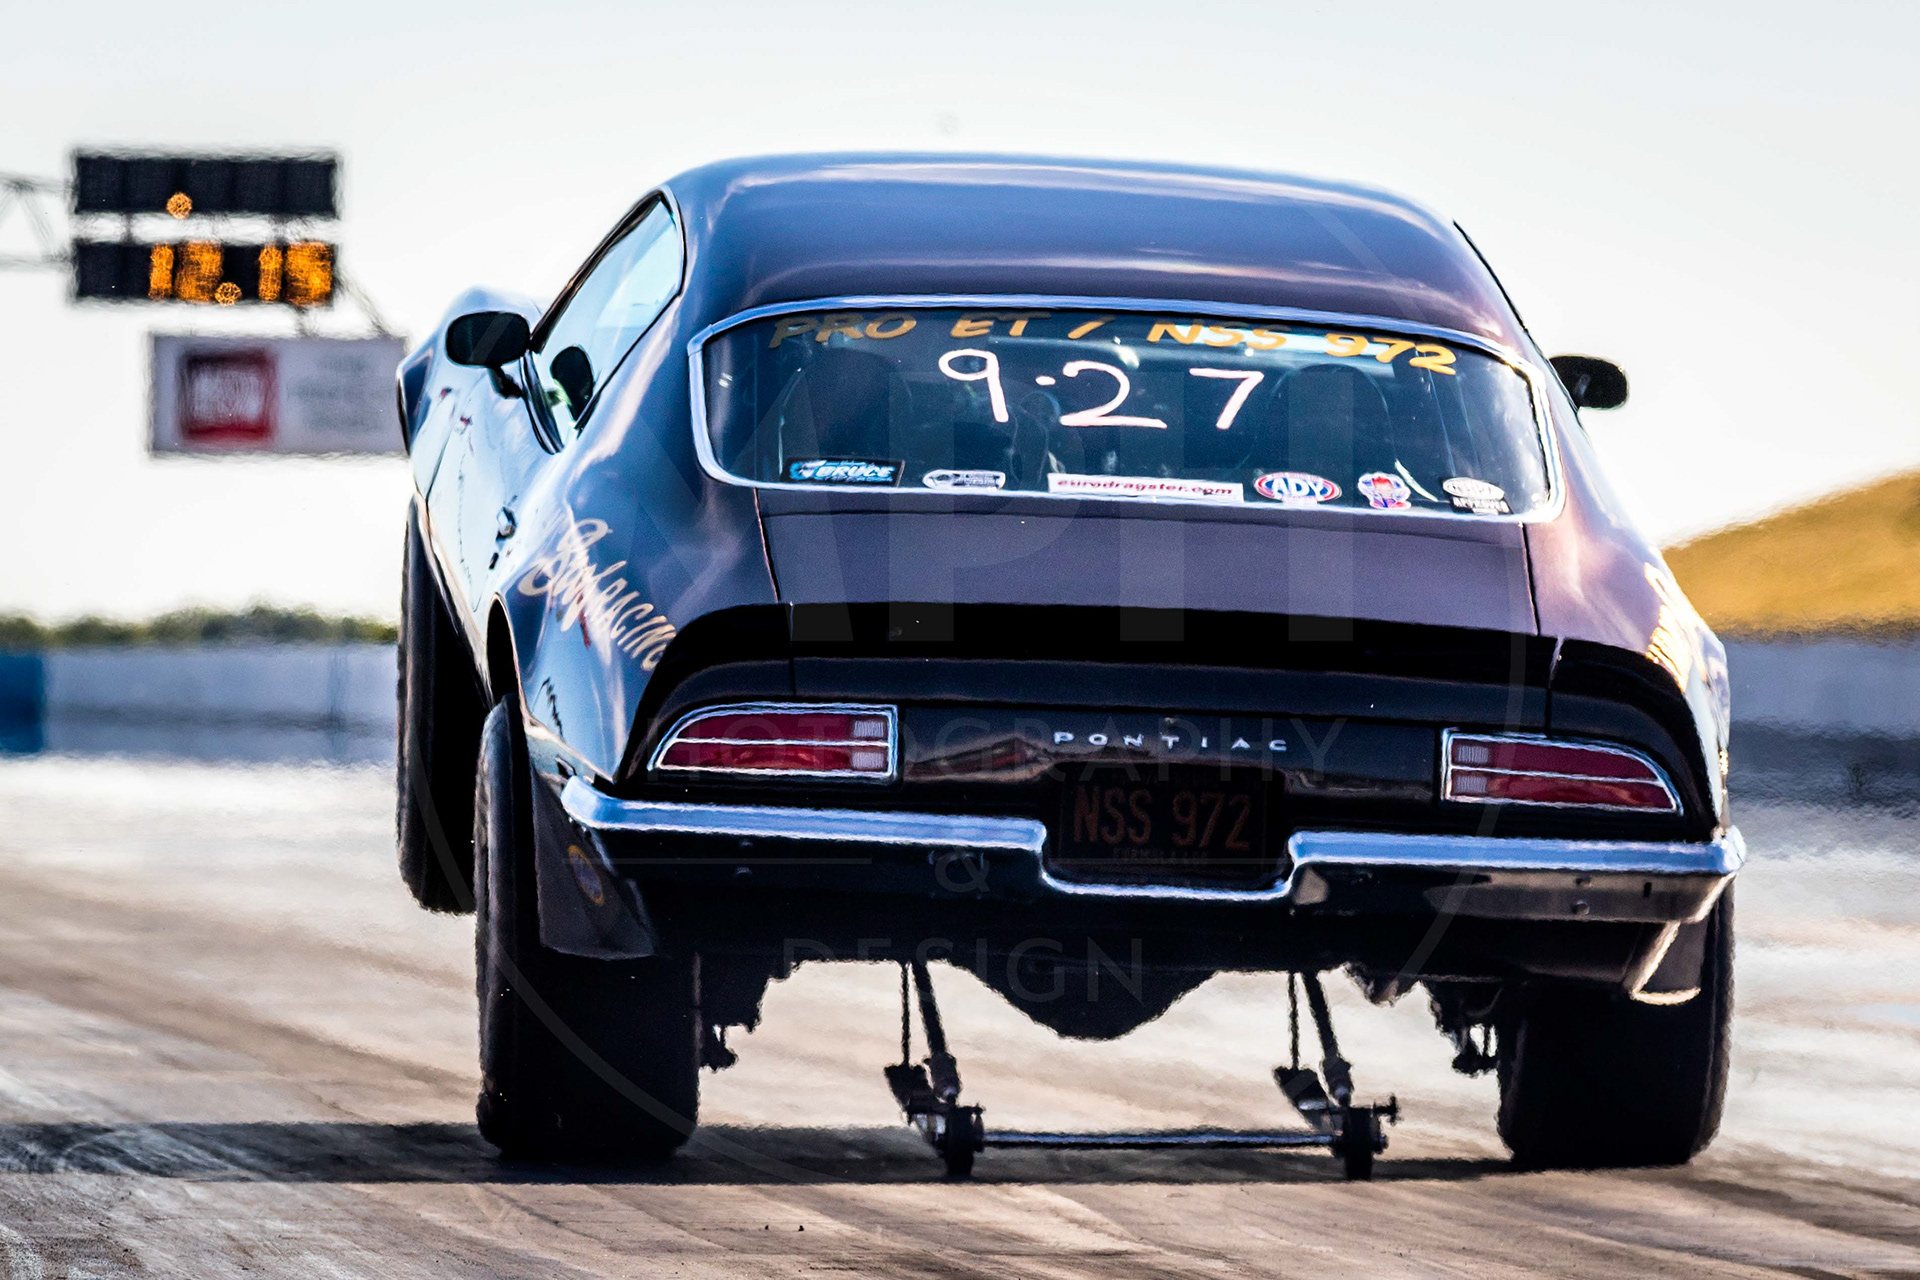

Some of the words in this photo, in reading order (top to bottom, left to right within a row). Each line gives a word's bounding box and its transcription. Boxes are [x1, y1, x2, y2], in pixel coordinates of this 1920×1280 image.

[768, 312, 916, 349] PRO
[950, 311, 1051, 338] ET
[1146, 320, 1291, 351] NSS
[1325, 331, 1457, 376] 972
[1057, 478, 1233, 496] eurodragster.com
[1053, 731, 1288, 751] PONTIAC
[1073, 785, 1151, 845] NSS
[1171, 790, 1250, 851] 972
